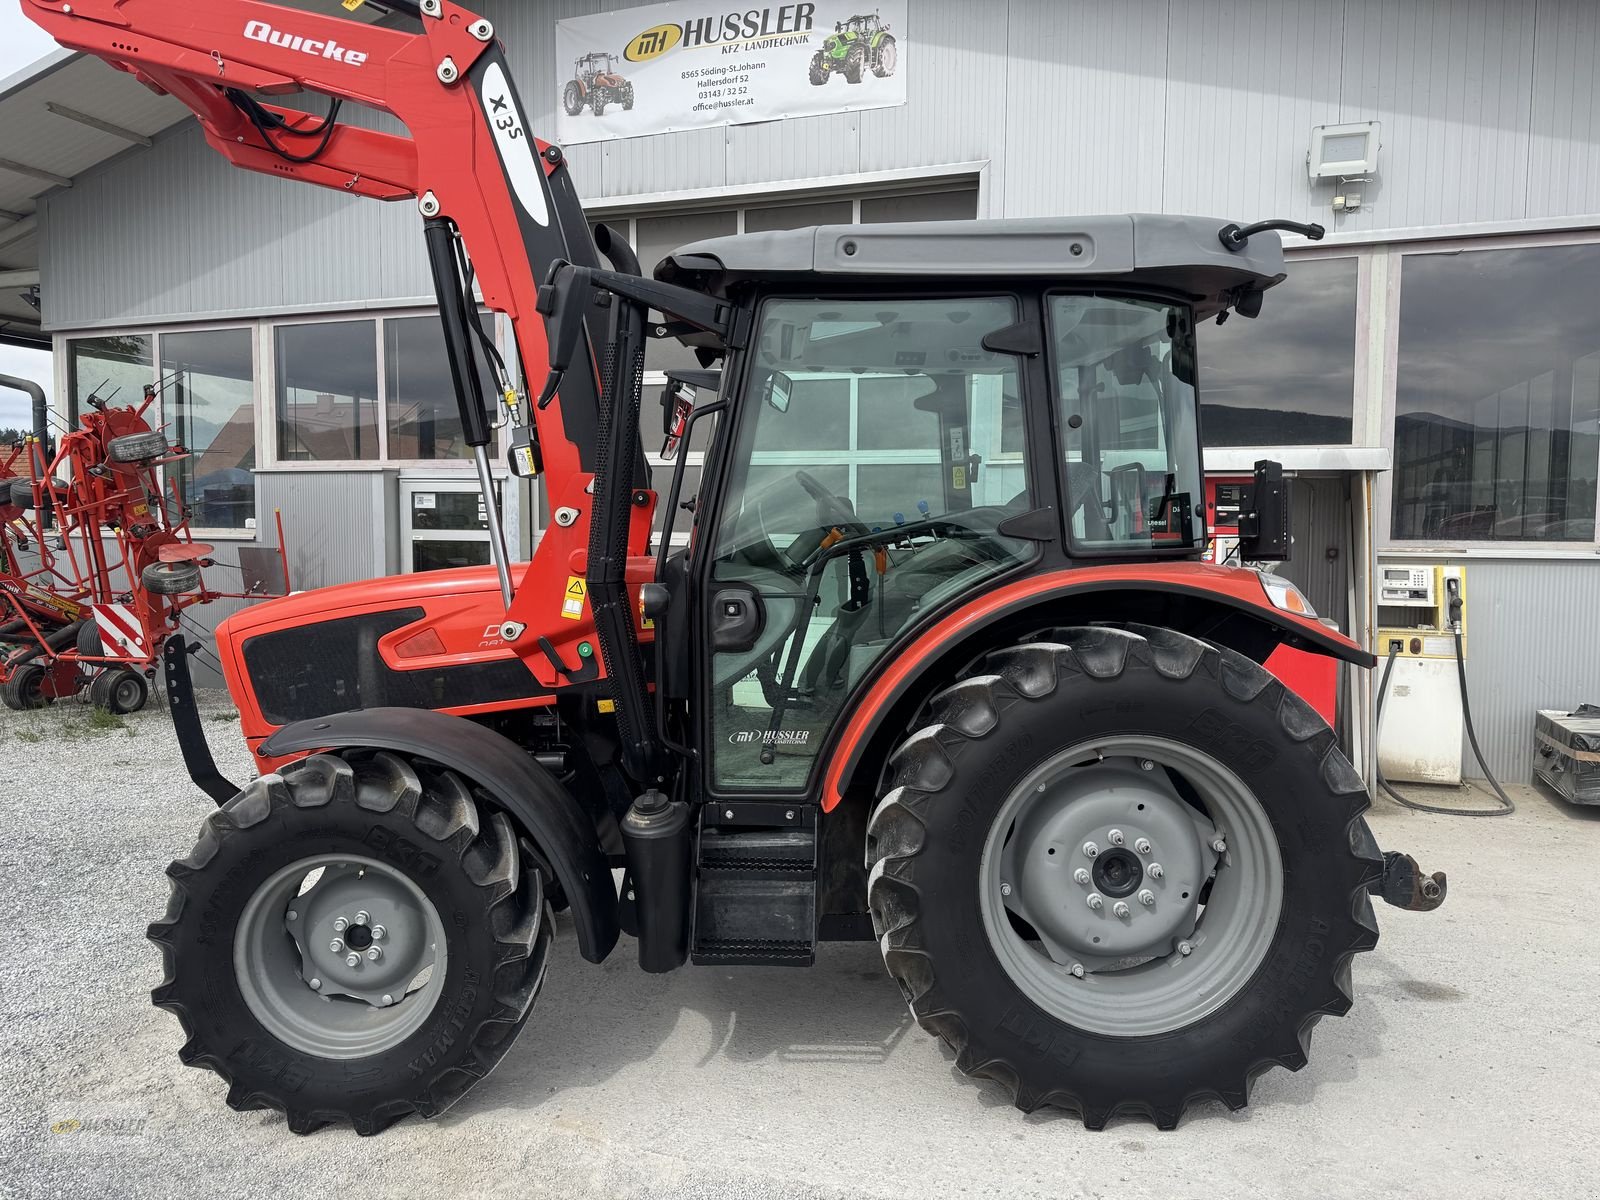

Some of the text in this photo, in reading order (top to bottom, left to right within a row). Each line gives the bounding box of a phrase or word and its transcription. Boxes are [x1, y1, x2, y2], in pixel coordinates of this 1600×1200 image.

[682, 2, 815, 47] HUSSLER
[243, 20, 368, 67] Quicke
[721, 34, 809, 54] KFZ LANDTECHNIK
[681, 62, 766, 79] 8565 Söding-St.Johann
[697, 76, 738, 88] Hallersdorf
[698, 90, 721, 99] 03143
[727, 87, 736, 95] 32
[738, 86, 748, 94] 52
[692, 98, 754, 111] office@hussler.at
[763, 730, 809, 740] HUSSLER
